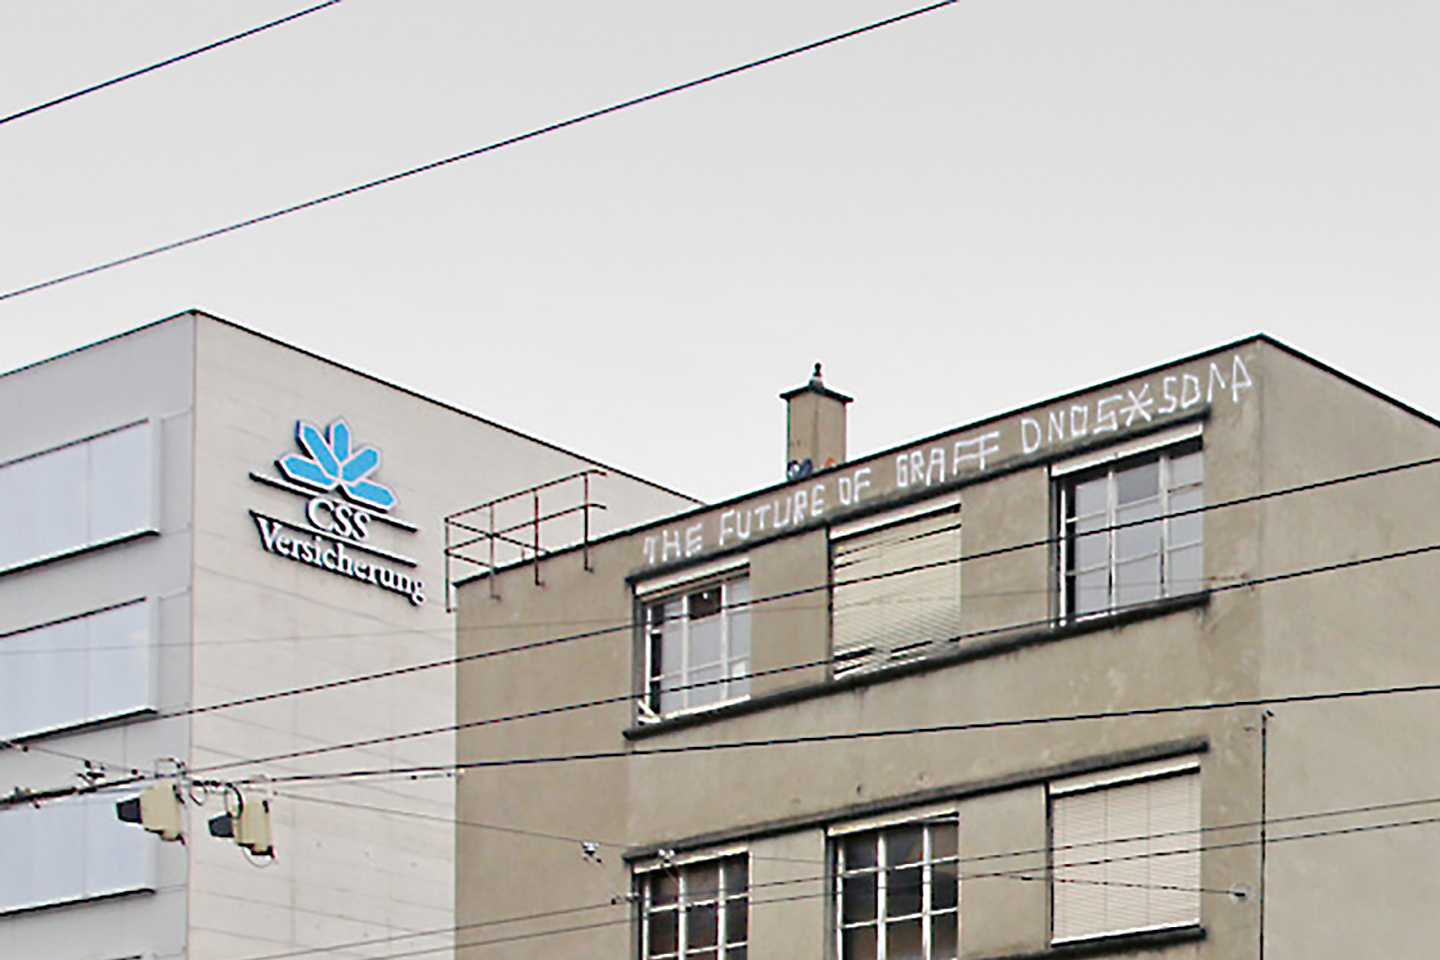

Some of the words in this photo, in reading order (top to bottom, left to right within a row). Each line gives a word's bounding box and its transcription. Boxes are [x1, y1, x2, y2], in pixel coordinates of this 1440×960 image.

[306, 497, 373, 542] CSS
[643, 524, 704, 565] THE
[718, 484, 826, 546] FUTURE
[838, 467, 872, 506] OF
[895, 431, 1001, 488] GRAFF
[255, 514, 428, 607] Versicherung
